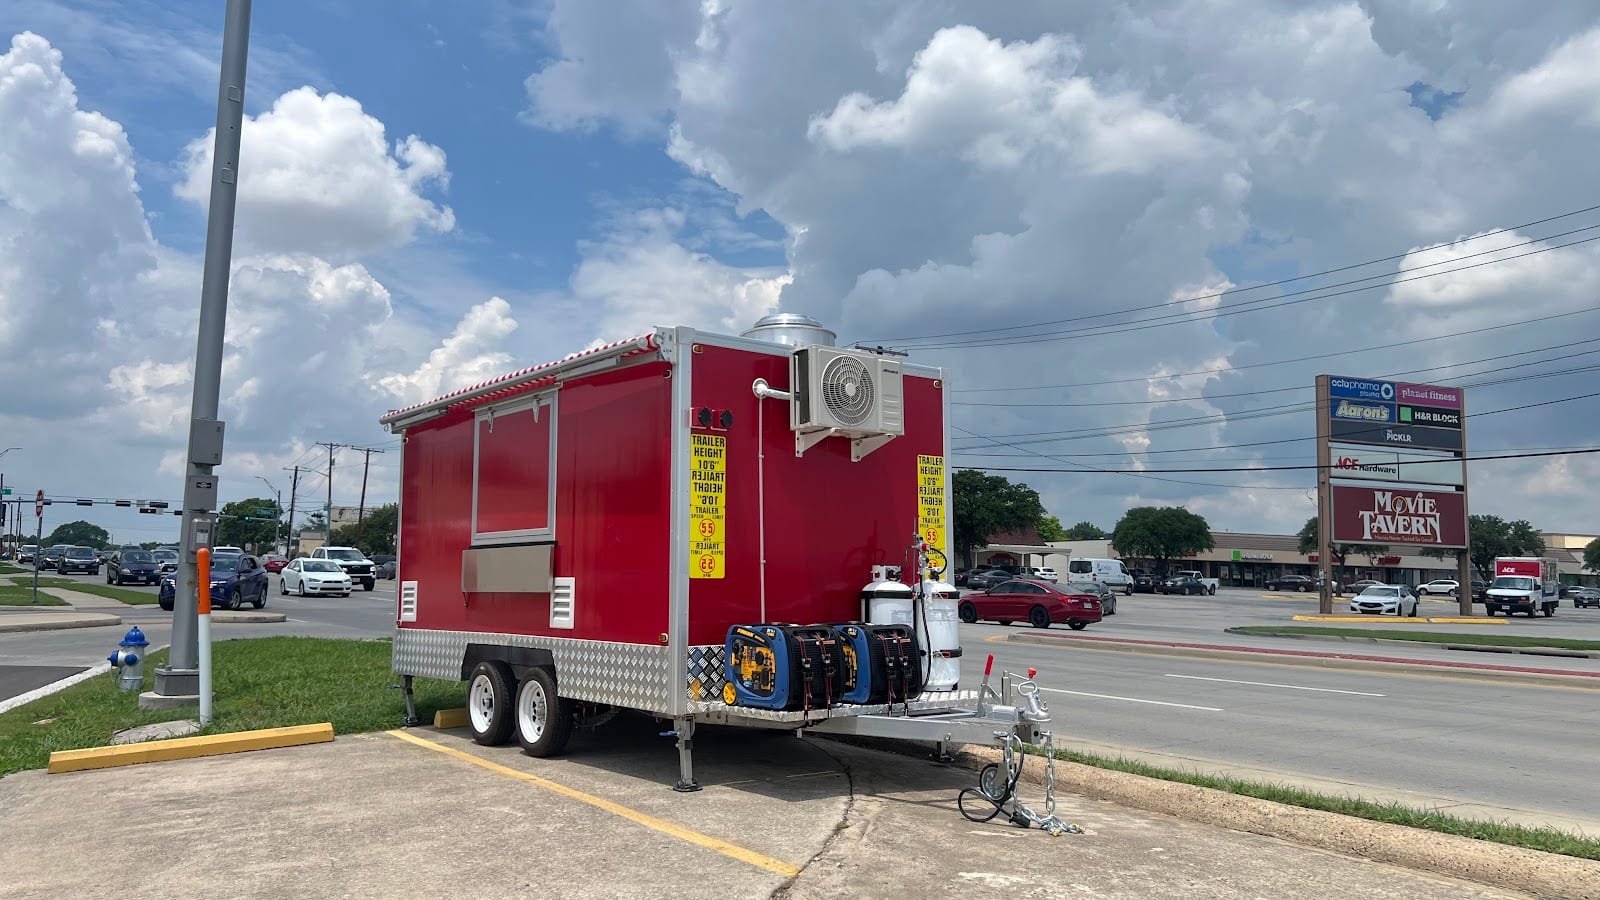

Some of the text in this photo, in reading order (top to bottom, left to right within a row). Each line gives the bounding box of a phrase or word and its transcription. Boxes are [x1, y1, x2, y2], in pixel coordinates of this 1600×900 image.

[1331, 379, 1380, 391] octapharma
[1402, 388, 1456, 401] planet fitness
[1336, 400, 1389, 420] Aaron's
[1414, 411, 1458, 424] H&R BLOCK
[692, 435, 725, 448] TRAILER
[1386, 433, 1411, 442] PICKLR
[694, 447, 722, 458] HEIGHT
[919, 456, 943, 466] TRAILER
[1335, 456, 1397, 474] ACE Hardware
[920, 466, 942, 476] HEIGHT
[1373, 490, 1437, 514] MOVIE
[701, 522, 713, 534] 55
[1358, 511, 1442, 543] TAVERN
[927, 531, 936, 541] 55
